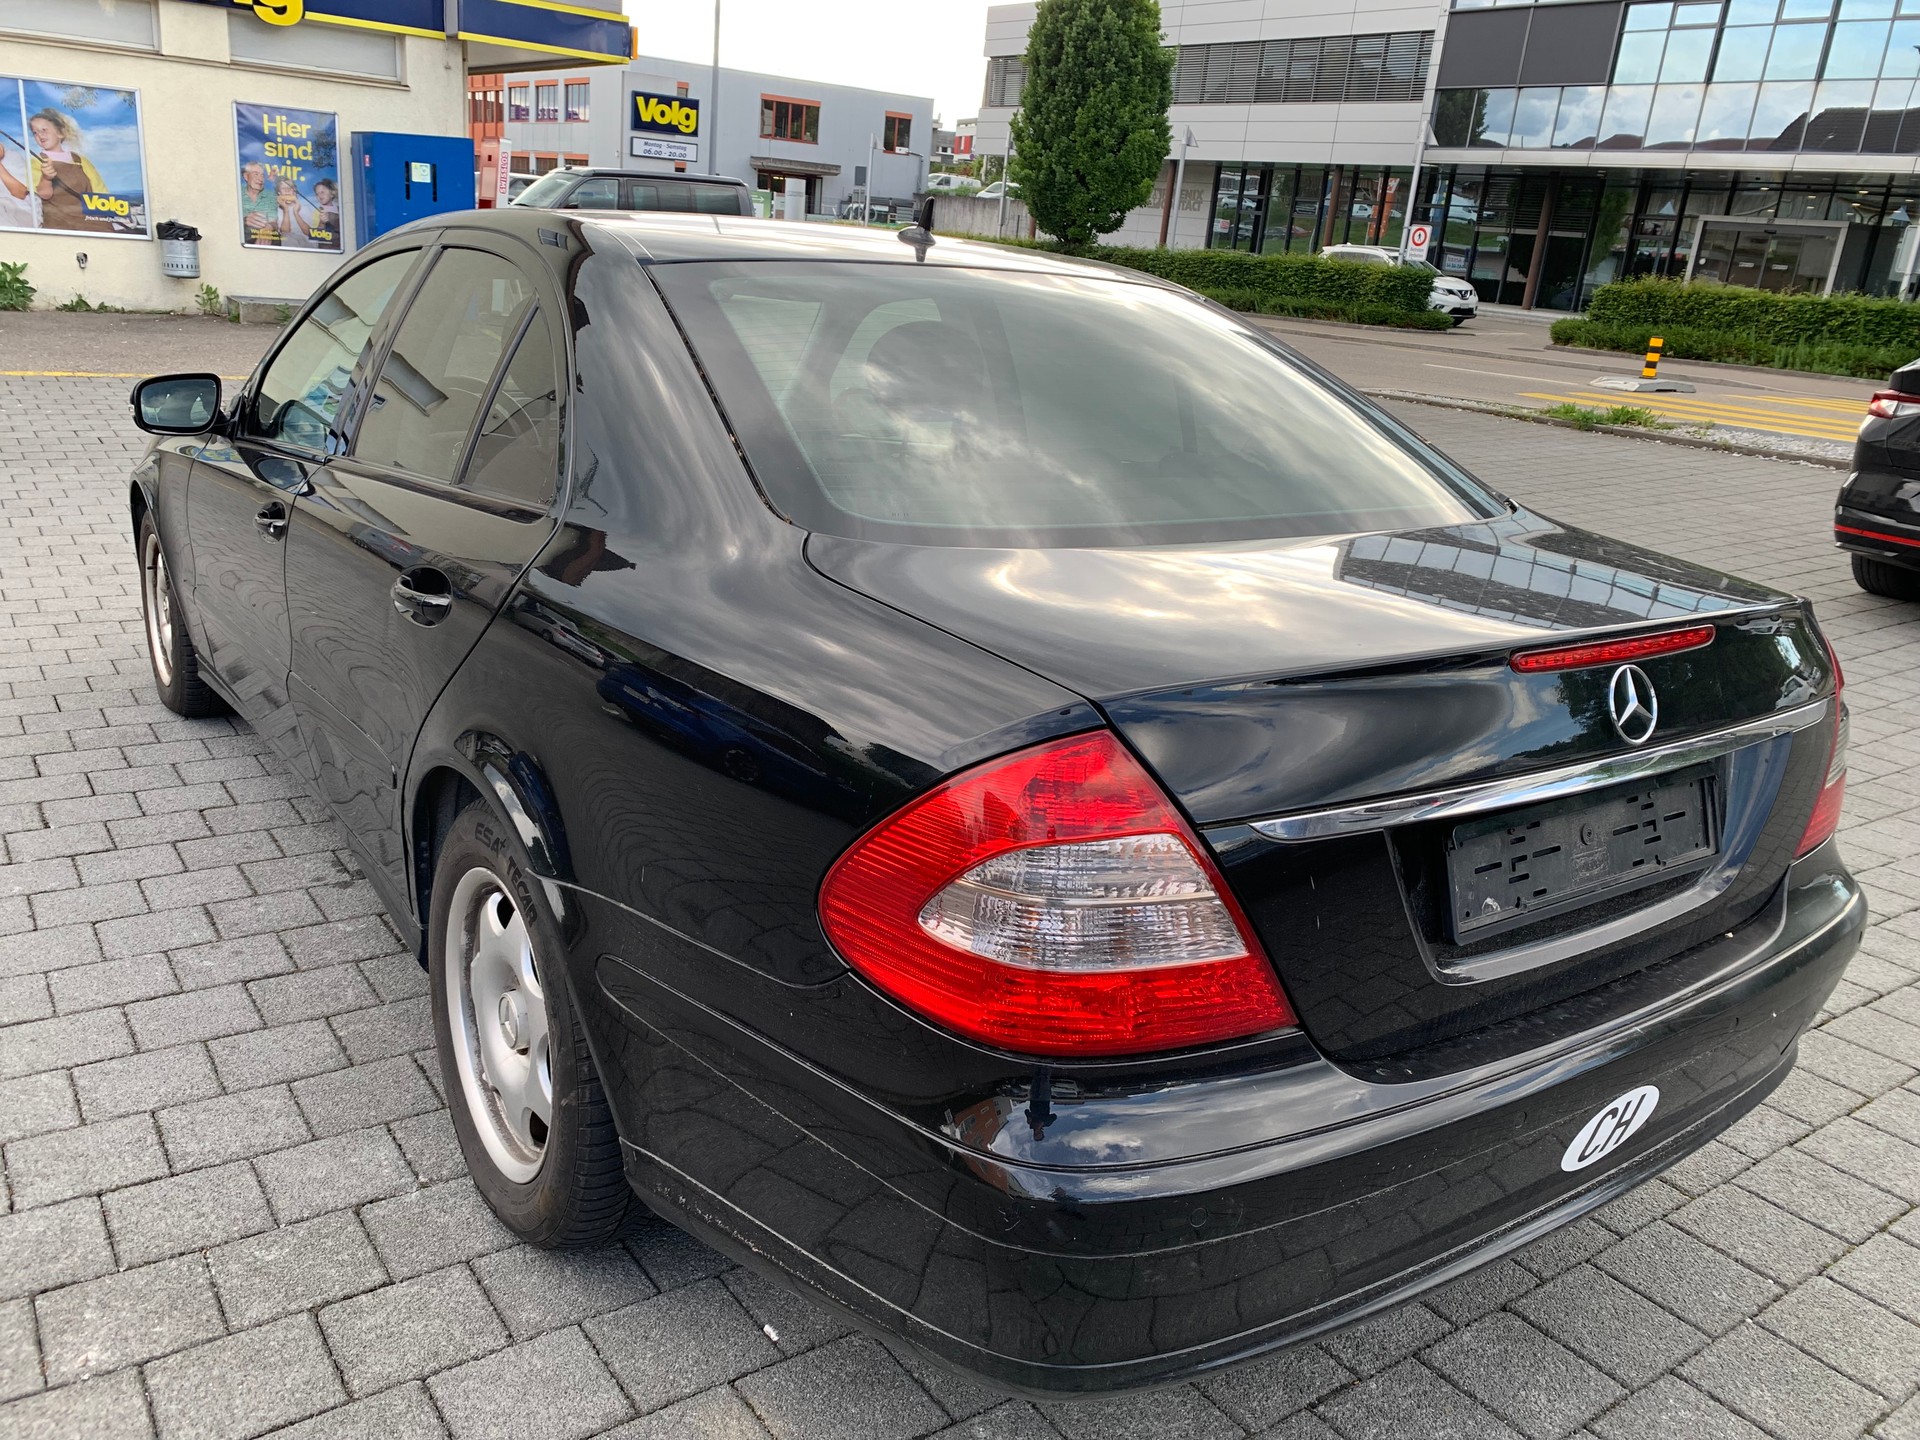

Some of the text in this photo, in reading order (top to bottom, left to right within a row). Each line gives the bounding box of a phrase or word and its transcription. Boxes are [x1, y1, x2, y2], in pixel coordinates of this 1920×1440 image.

[262, 113, 312, 139] Hier
[635, 95, 698, 134] Volg
[263, 136, 313, 161] sind
[643, 147, 663, 156] 06.00
[668, 151, 687, 159] 20.00
[499, 151, 509, 195] SWISSLOS
[82, 193, 130, 217] Volg
[308, 228, 333, 241] Volg
[506, 855, 538, 929] TECAR
[1577, 1092, 1648, 1163] CH
